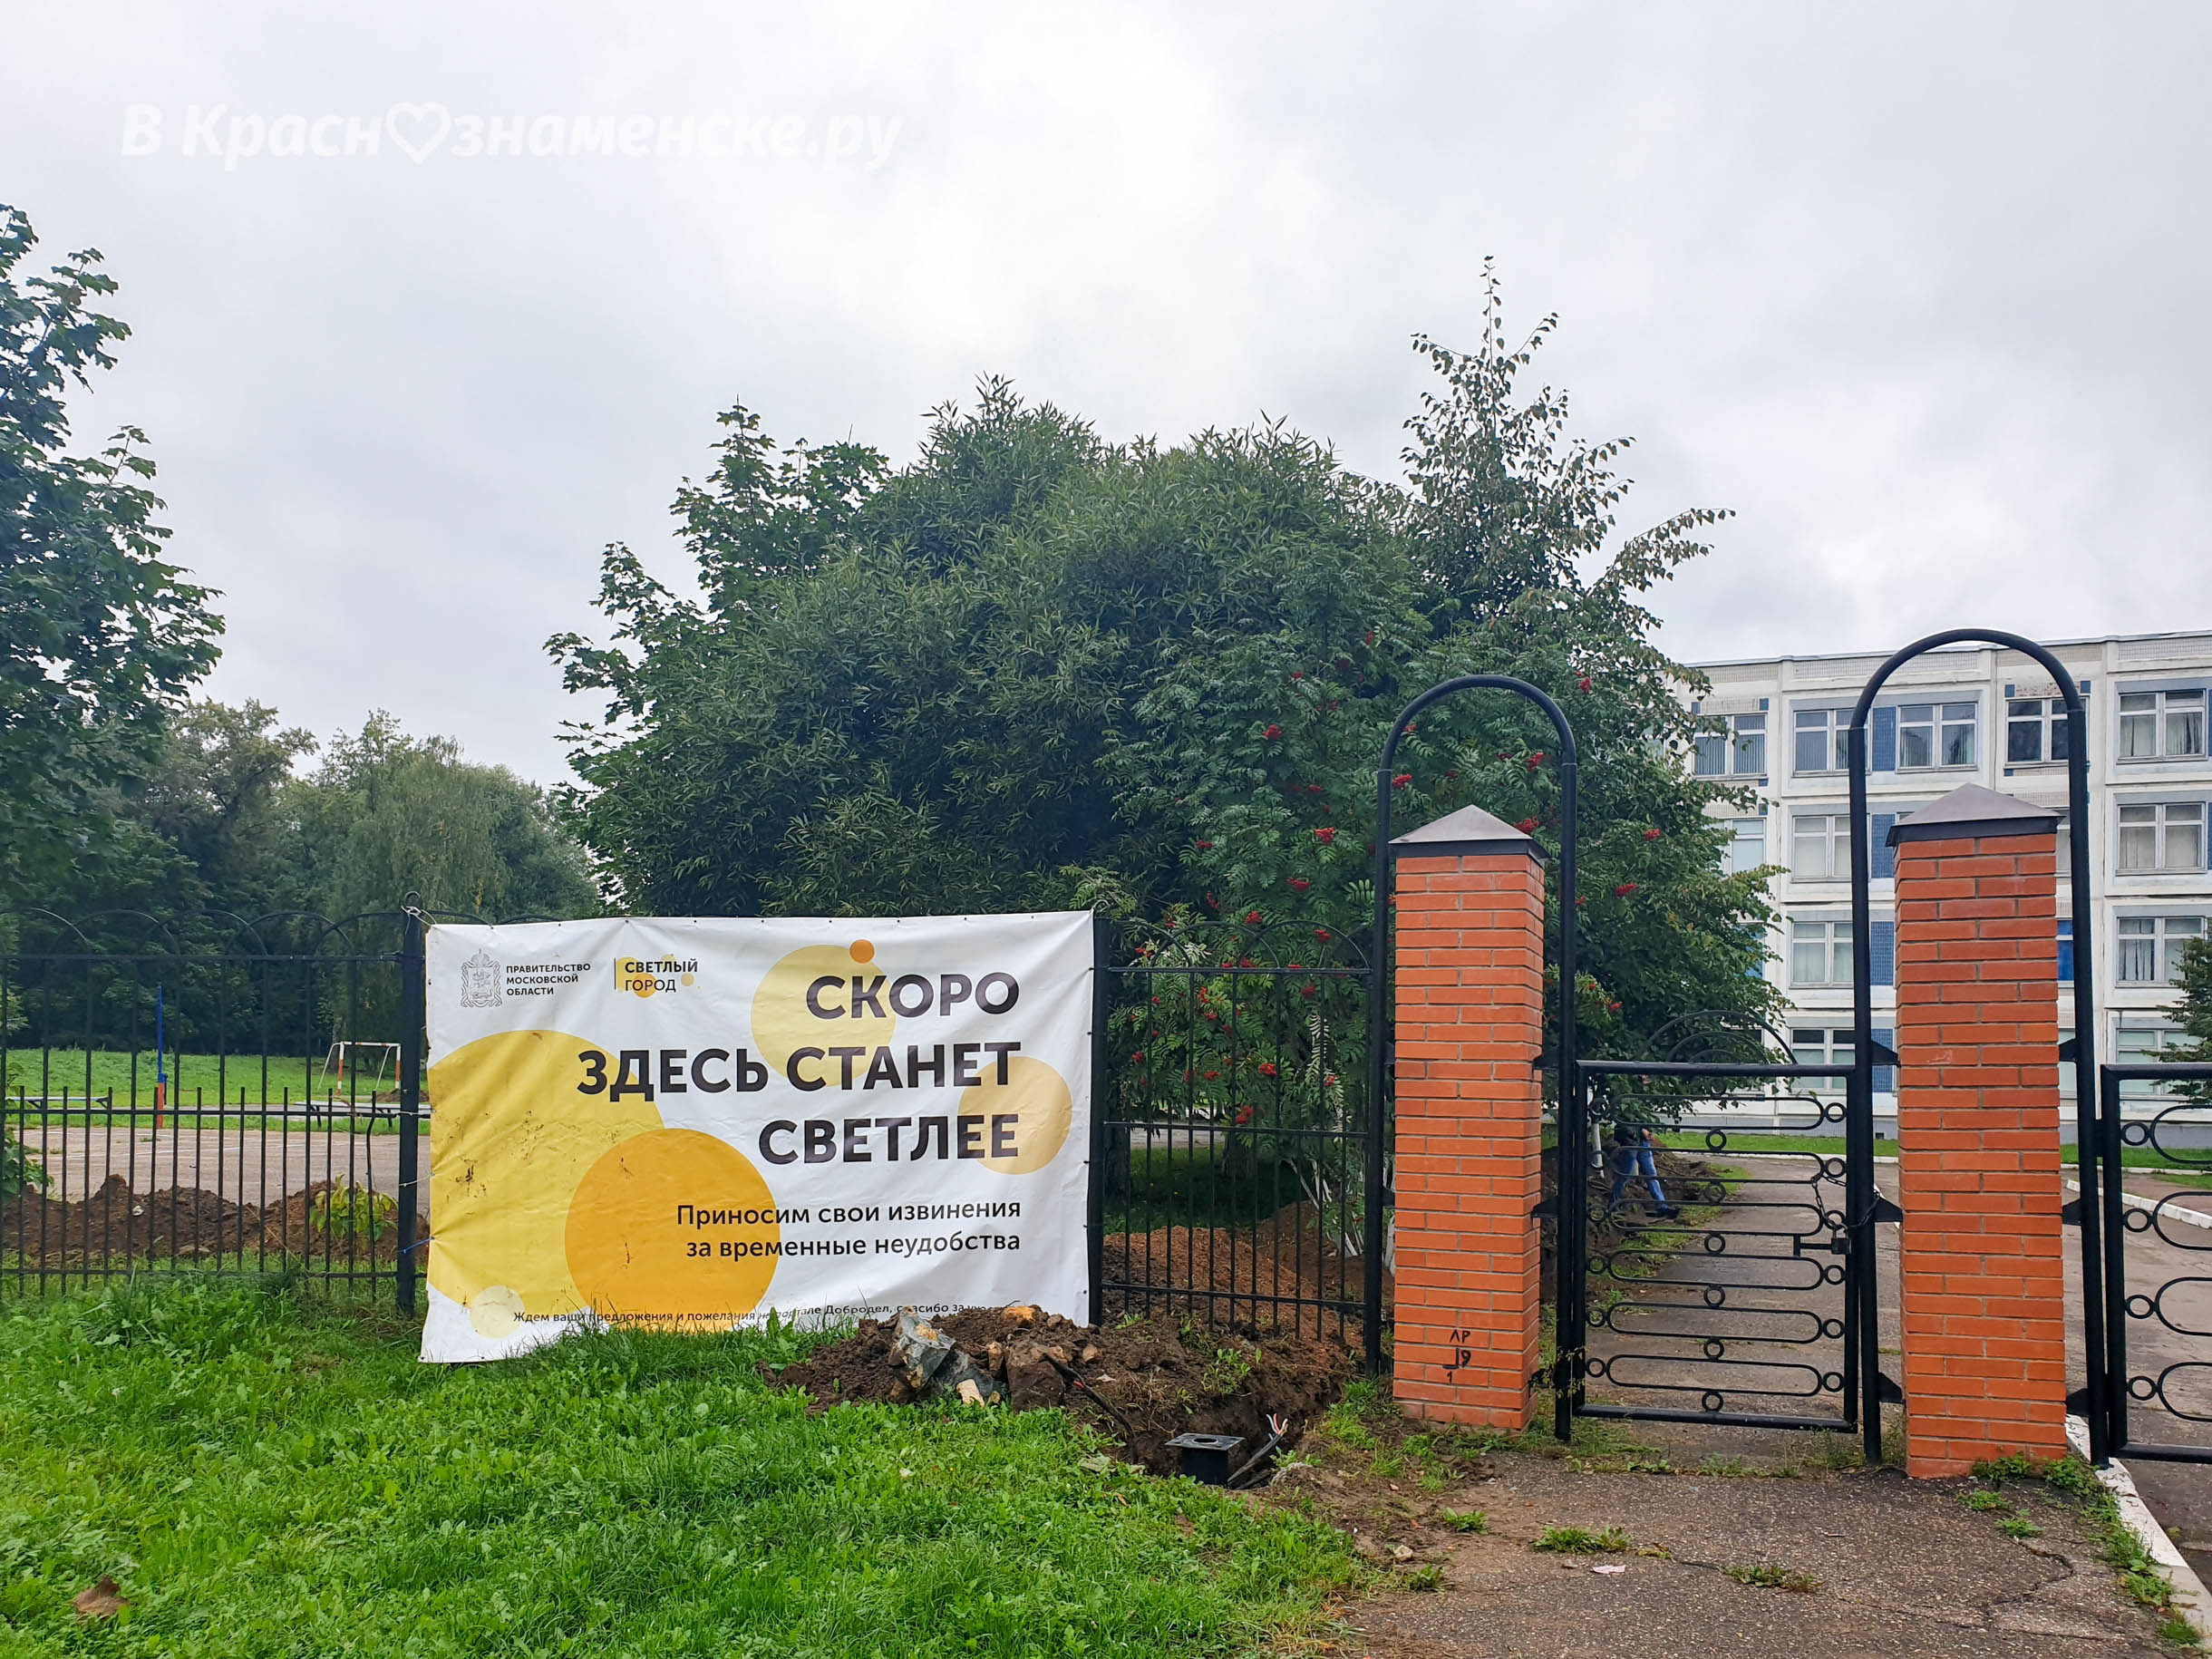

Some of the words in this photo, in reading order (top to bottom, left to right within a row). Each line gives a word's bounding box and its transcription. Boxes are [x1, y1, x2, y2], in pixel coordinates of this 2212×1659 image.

[506, 963, 591, 974] ПРАВИТЕЛЬСТВО
[625, 958, 698, 974] СВЕТЛЫЙ
[506, 974, 578, 985] МОСКОВСКОЙ
[625, 979, 676, 993] ГОРОД
[506, 986, 554, 996] ОБЛАСТИ
[806, 972, 1019, 1019] СКОРО
[577, 1048, 769, 1102] ЗДЕСЬ
[786, 1042, 1022, 1091] СТАНЕТ
[759, 1113, 1018, 1165] СВЕТЛЕЕ
[677, 1204, 810, 1227] Приносим
[818, 1207, 880, 1223] свои
[888, 1201, 1021, 1222] извинения
[686, 1243, 712, 1257] за
[719, 1238, 867, 1261] временные
[875, 1230, 1021, 1257] неудобства
[513, 1312, 549, 1324] Ждем
[687, 1312, 755, 1321] пожелания
[825, 1305, 893, 1316] Добродел,
[897, 1304, 949, 1313] сасибо
